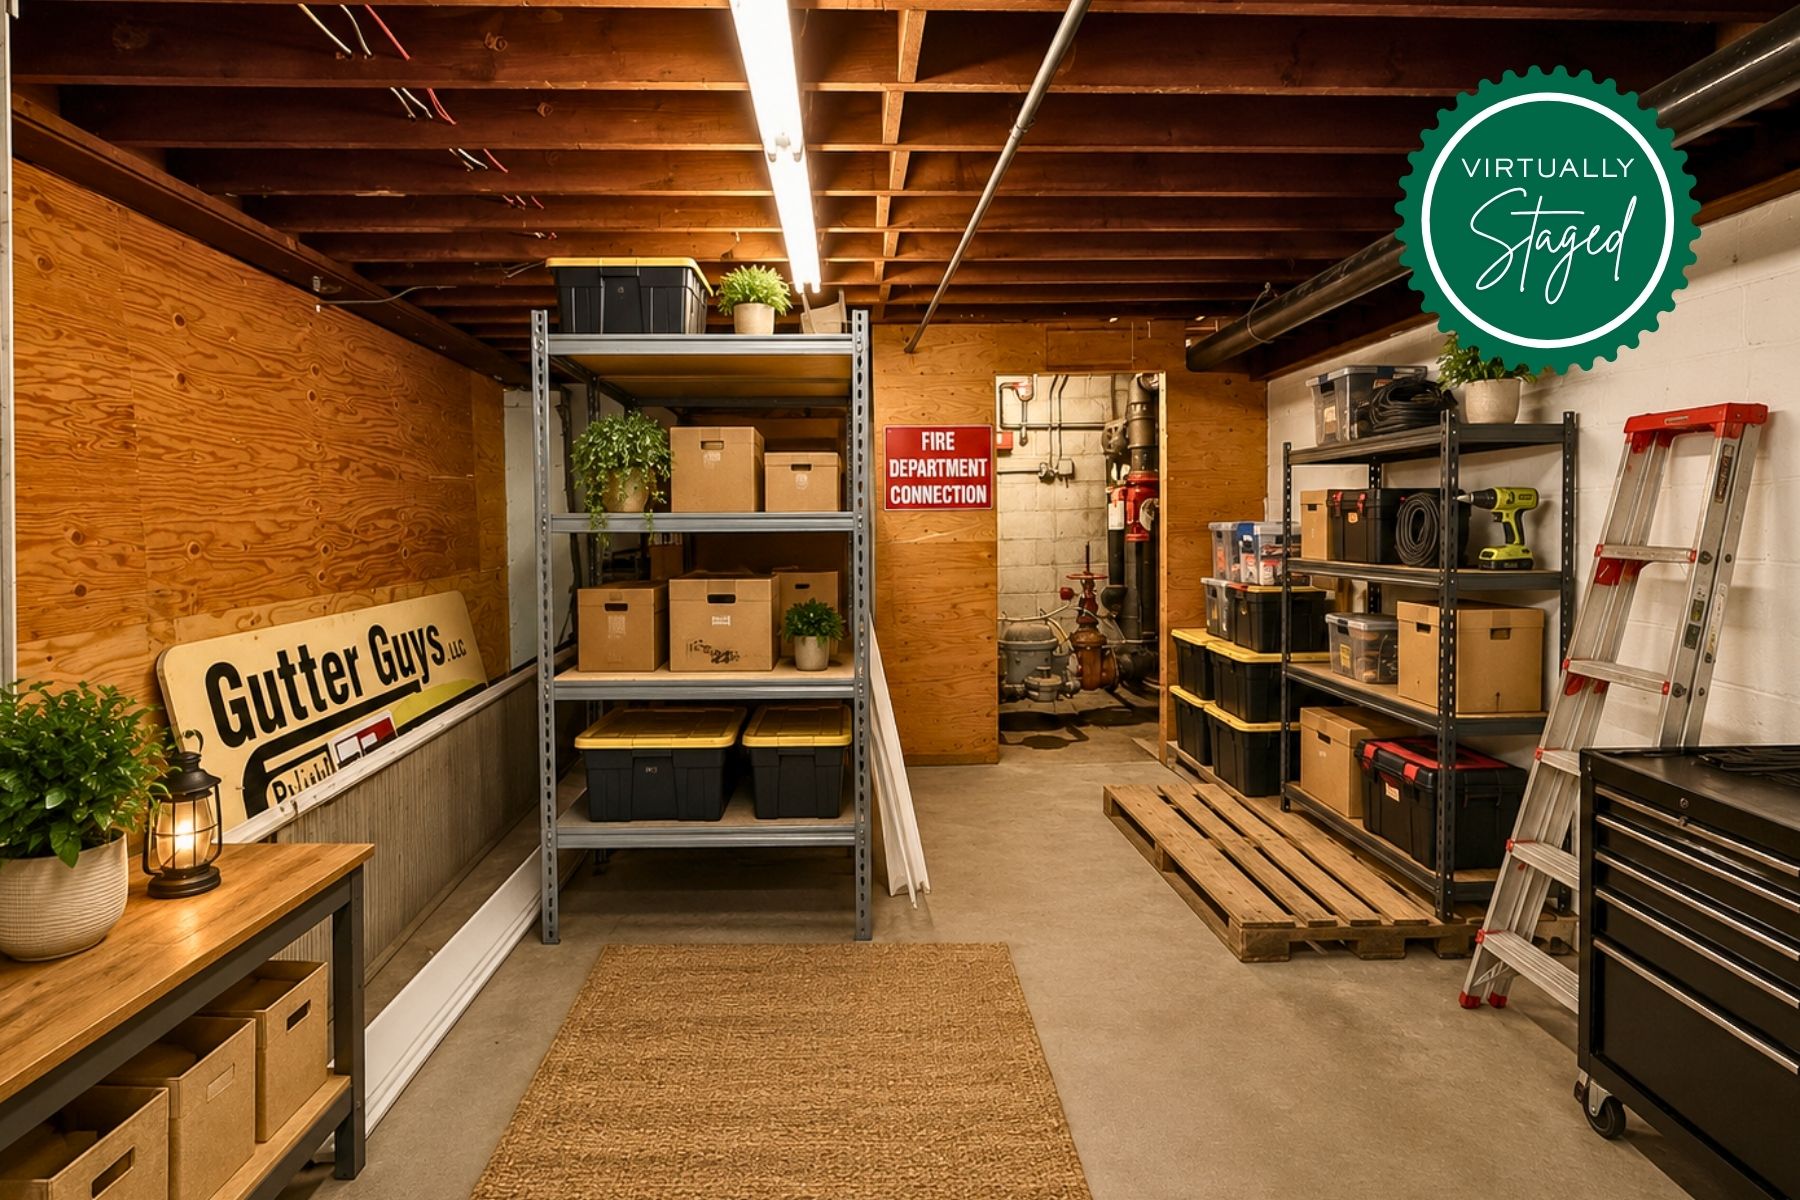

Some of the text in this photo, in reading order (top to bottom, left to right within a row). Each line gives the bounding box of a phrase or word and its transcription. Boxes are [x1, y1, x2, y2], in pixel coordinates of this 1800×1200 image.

[921, 431, 955, 451] FIRE
[889, 458, 988, 478] DEPARTMENT
[890, 484, 987, 505] CONNECTION
[205, 644, 363, 748] Gutter
[368, 624, 445, 684] Guys
